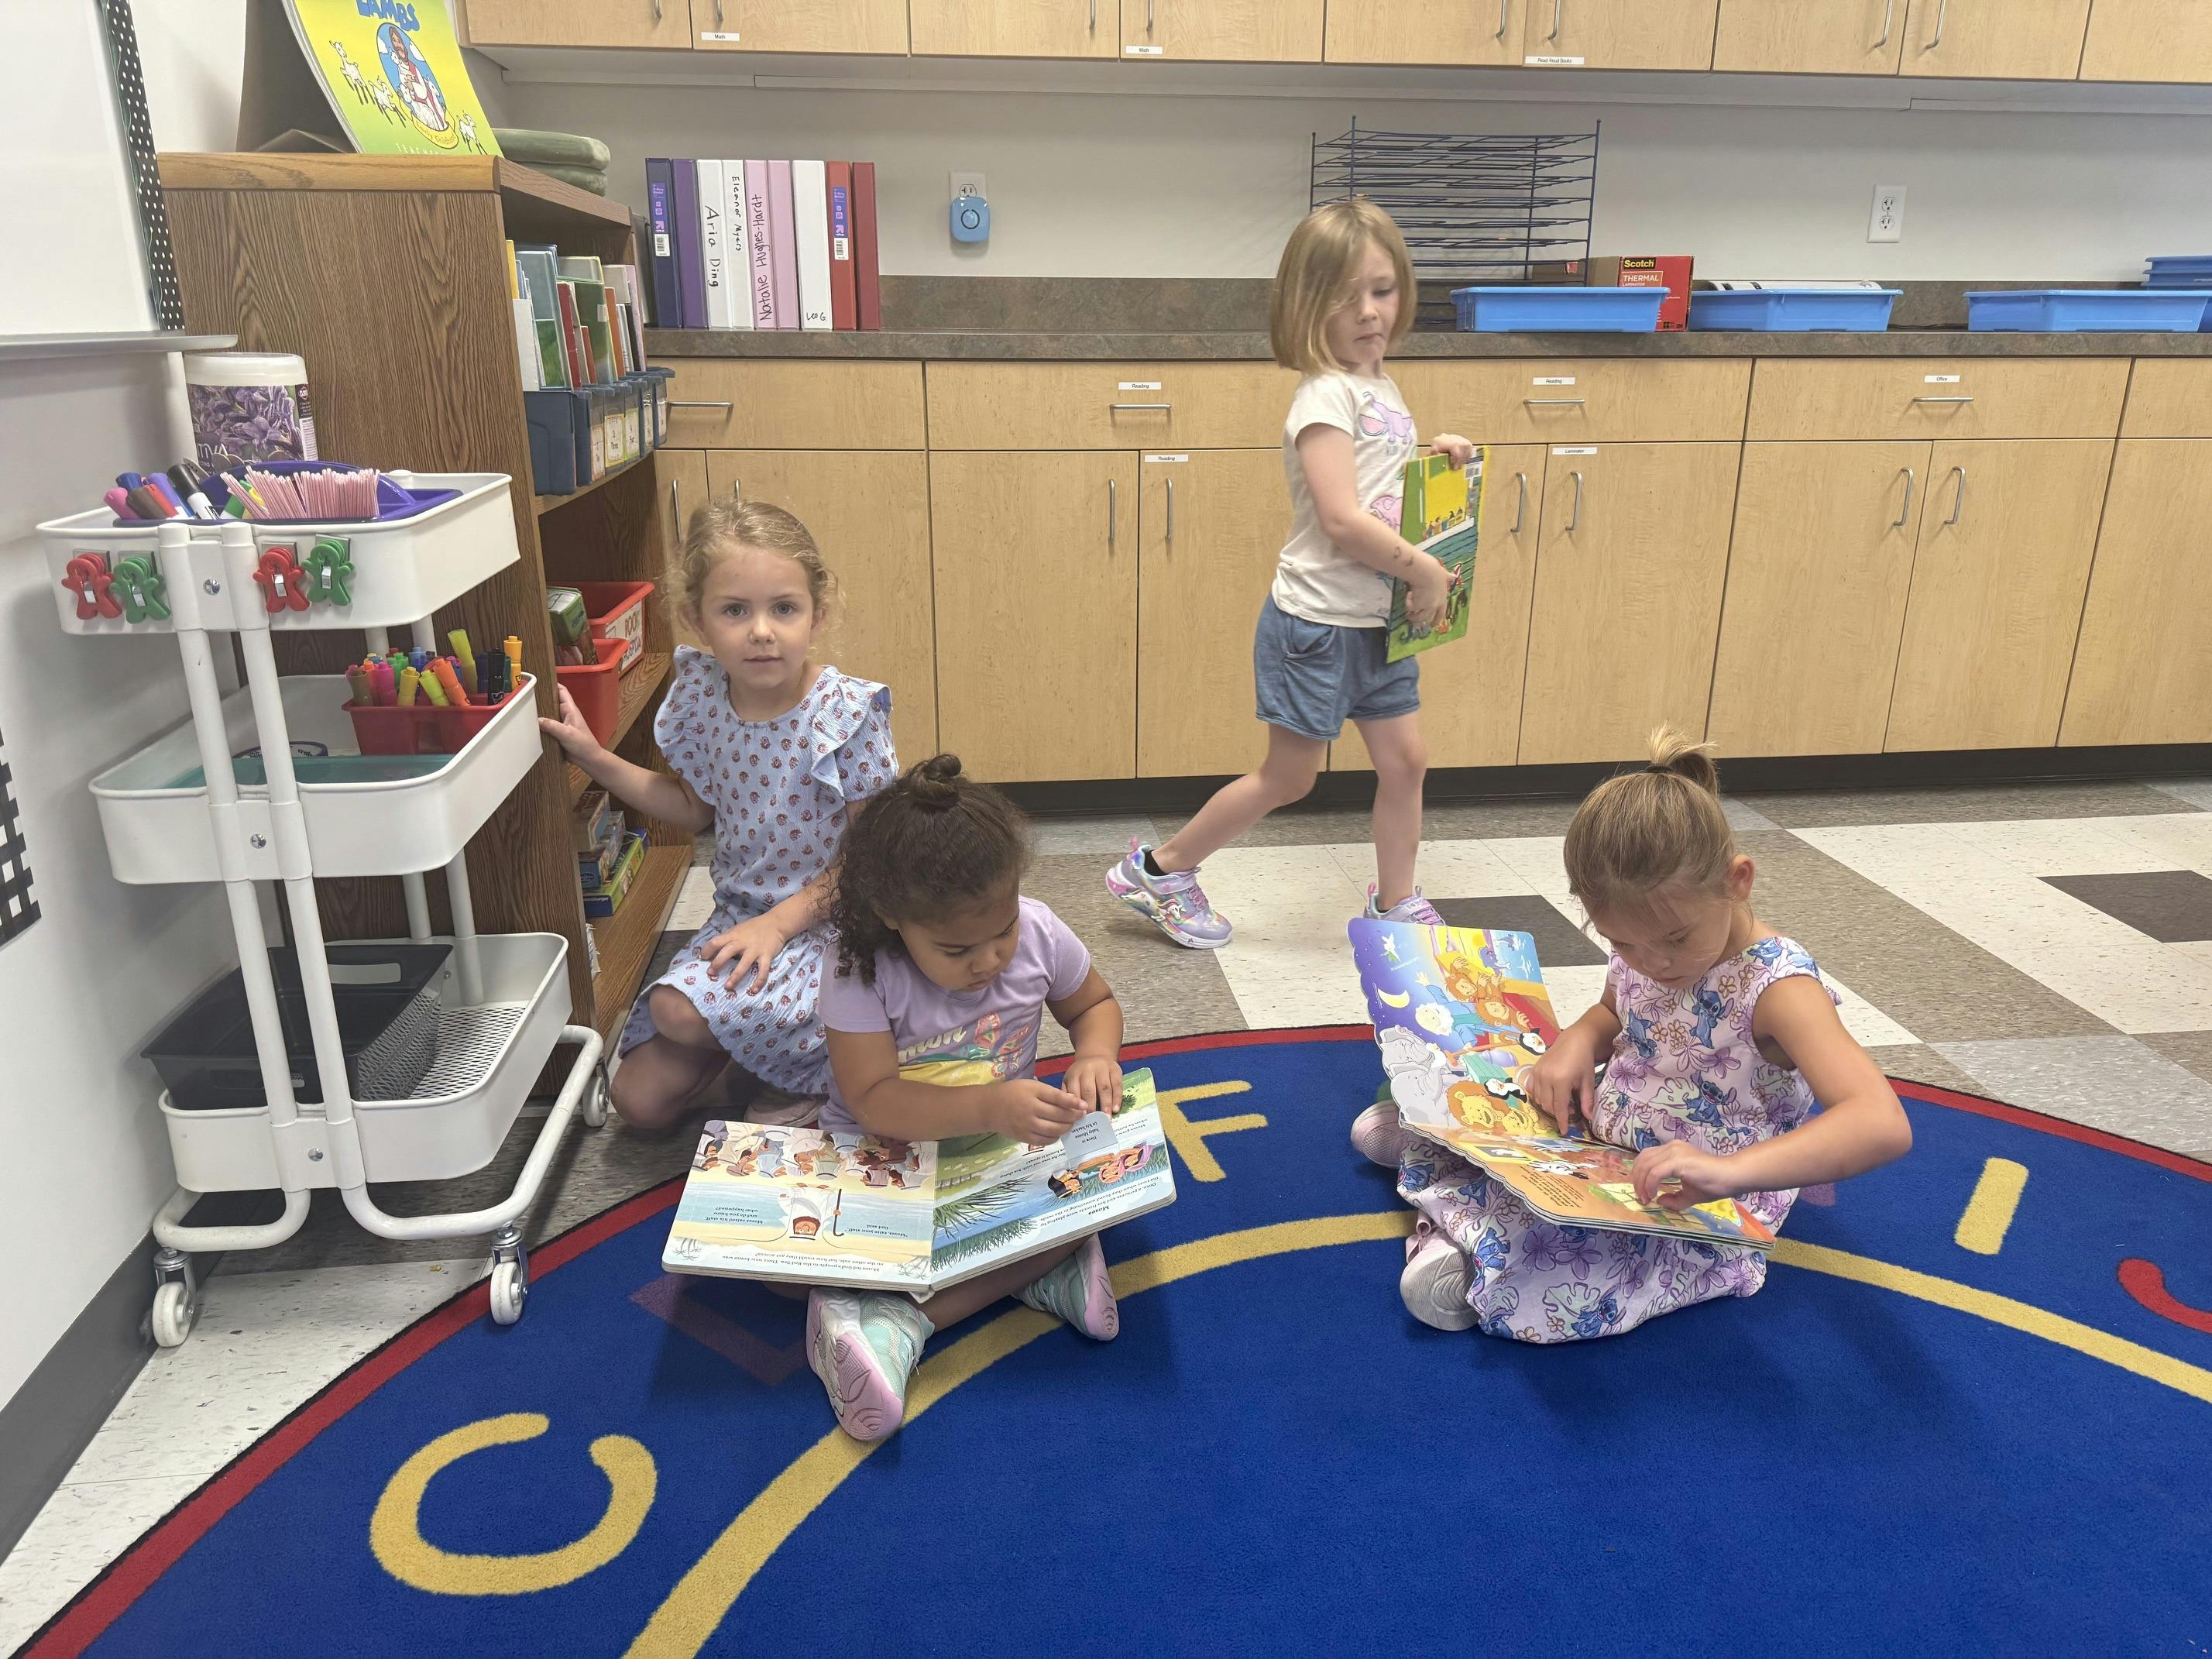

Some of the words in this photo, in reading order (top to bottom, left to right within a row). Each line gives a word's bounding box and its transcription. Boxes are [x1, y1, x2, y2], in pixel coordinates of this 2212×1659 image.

[732, 177, 741, 218] Eleanor
[706, 205, 720, 248] Aria
[733, 224, 742, 252] Myers
[751, 194, 771, 268] Hughes-Hardt
[708, 258, 721, 288] Ding
[1624, 259, 1655, 268] Scotch
[758, 274, 773, 321] Natalie
[1087, 1204, 1109, 1216] Moses
[1955, 1157, 2028, 1255] I
[369, 1411, 658, 1595] C
